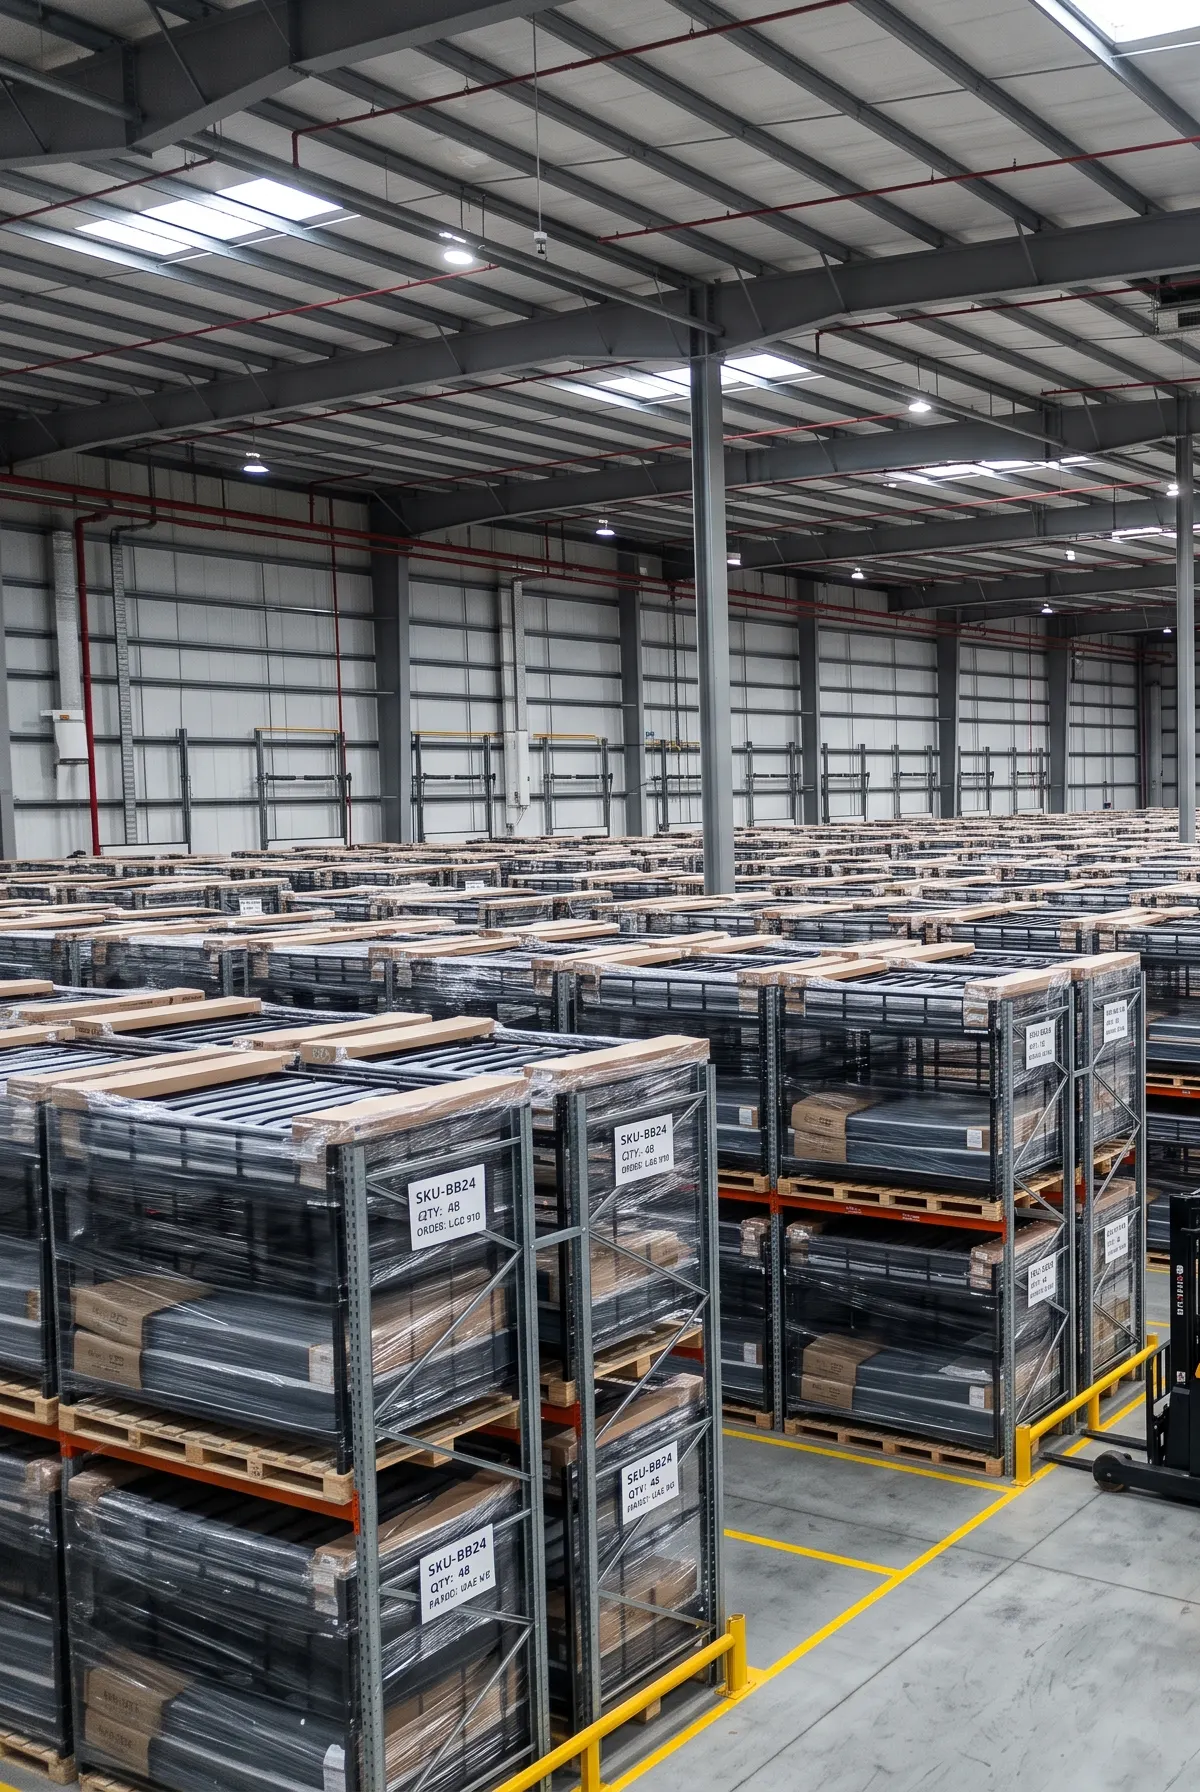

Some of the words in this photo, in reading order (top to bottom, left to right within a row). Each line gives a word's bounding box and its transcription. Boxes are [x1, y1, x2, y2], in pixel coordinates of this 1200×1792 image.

[621, 1124, 667, 1146] SKU-BB24
[416, 1177, 476, 1205] SKU-BB24
[418, 1206, 443, 1222] QTY:
[428, 1537, 487, 1577] SKU-BB24
[430, 1575, 453, 1594] QTY:
